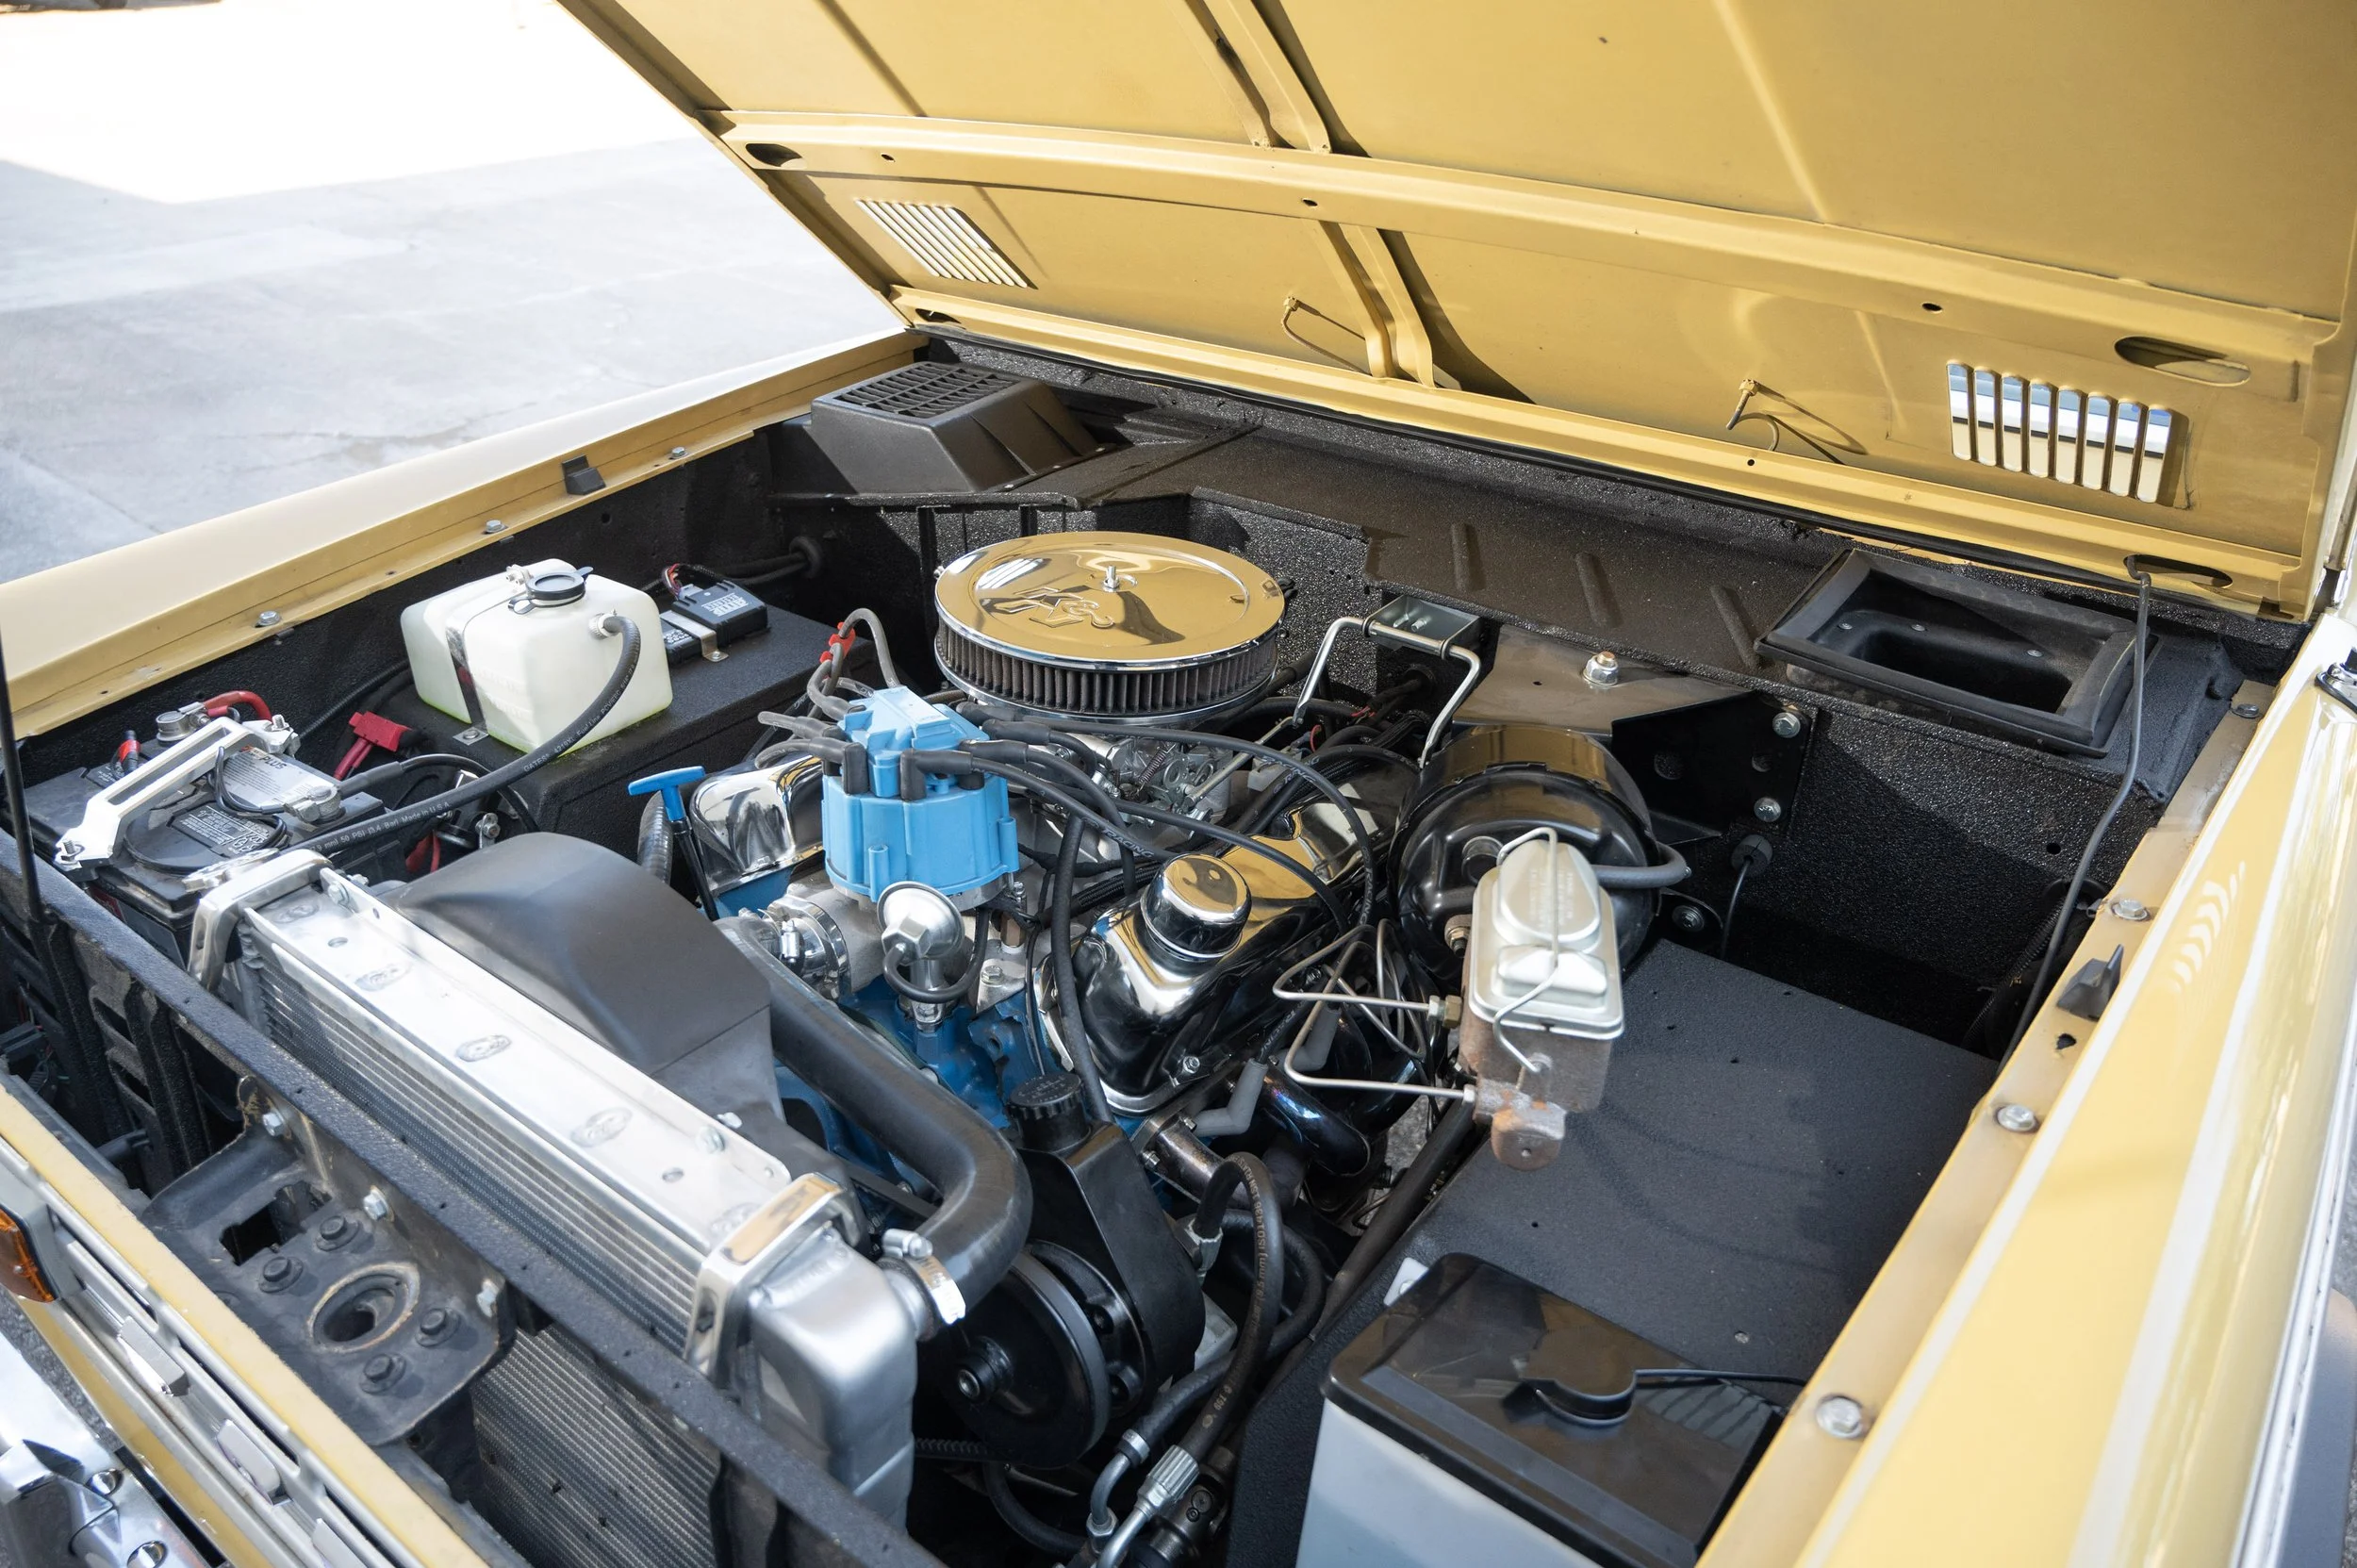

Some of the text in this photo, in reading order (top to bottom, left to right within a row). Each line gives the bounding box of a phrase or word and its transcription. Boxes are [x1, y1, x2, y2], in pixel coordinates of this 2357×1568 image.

[260, 755, 288, 770] PLUS
[340, 834, 350, 844] 50
[402, 812, 421, 823] Made
[1102, 830, 1155, 857] RACING
